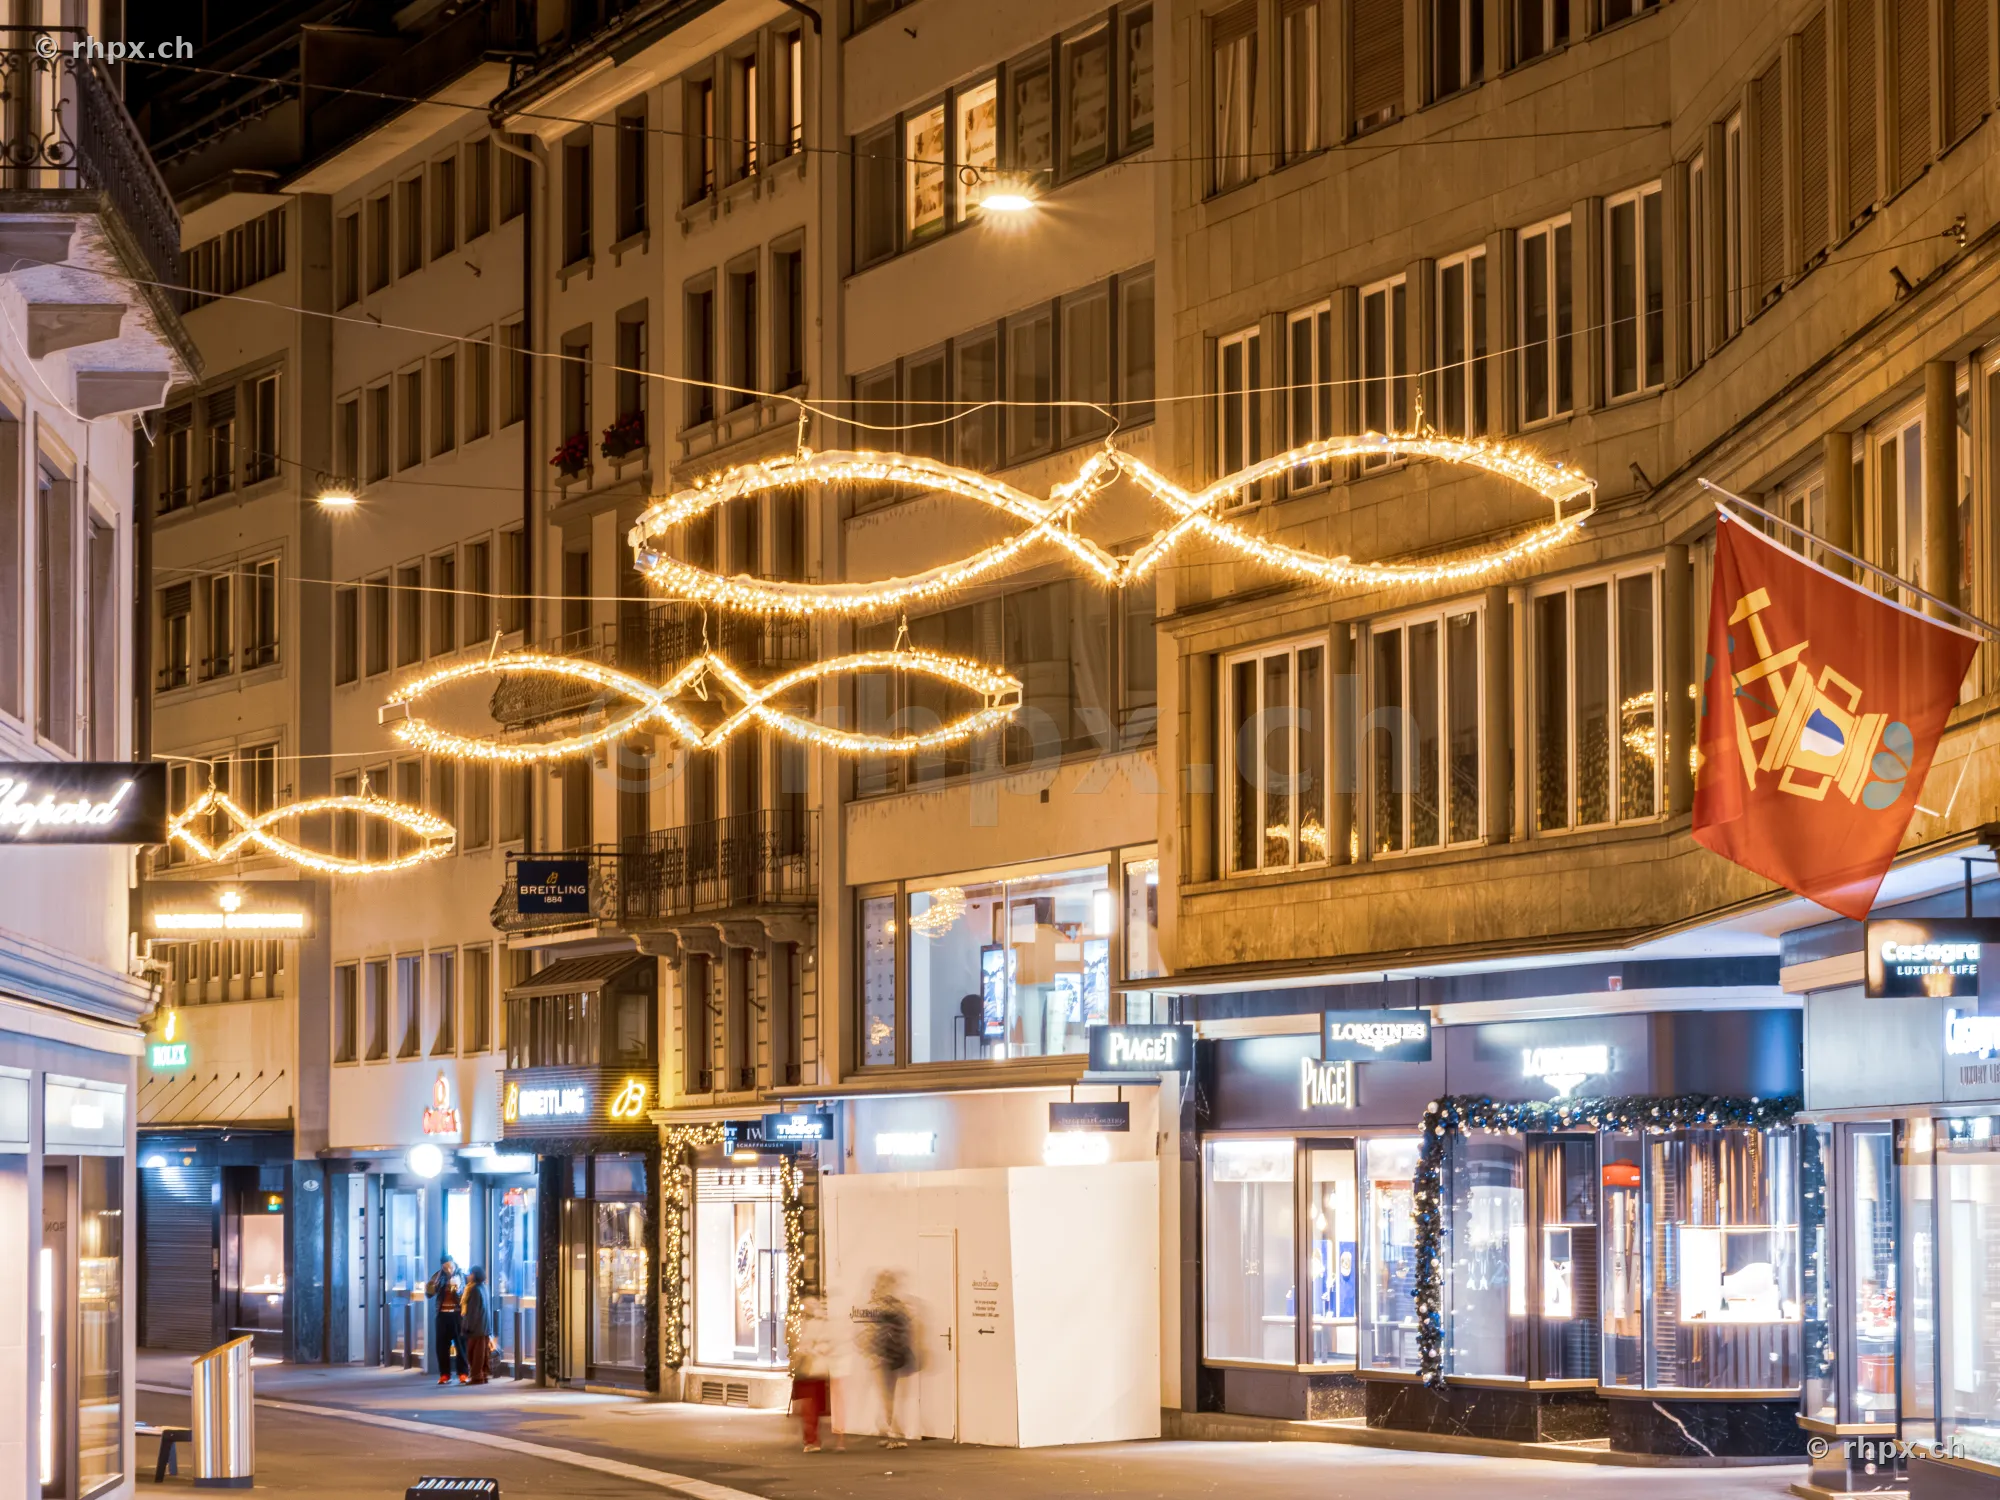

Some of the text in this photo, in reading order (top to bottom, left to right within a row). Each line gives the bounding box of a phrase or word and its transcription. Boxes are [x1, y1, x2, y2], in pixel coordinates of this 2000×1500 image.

[520, 885, 586, 895] BREITLING
[1897, 964, 1978, 976] LUXURY LIFE
[1331, 1023, 1426, 1040] LONGINES
[1109, 1032, 1177, 1065] PIAGET
[1301, 1056, 1353, 1110] PIAGET
[746, 1127, 762, 1140] IW
